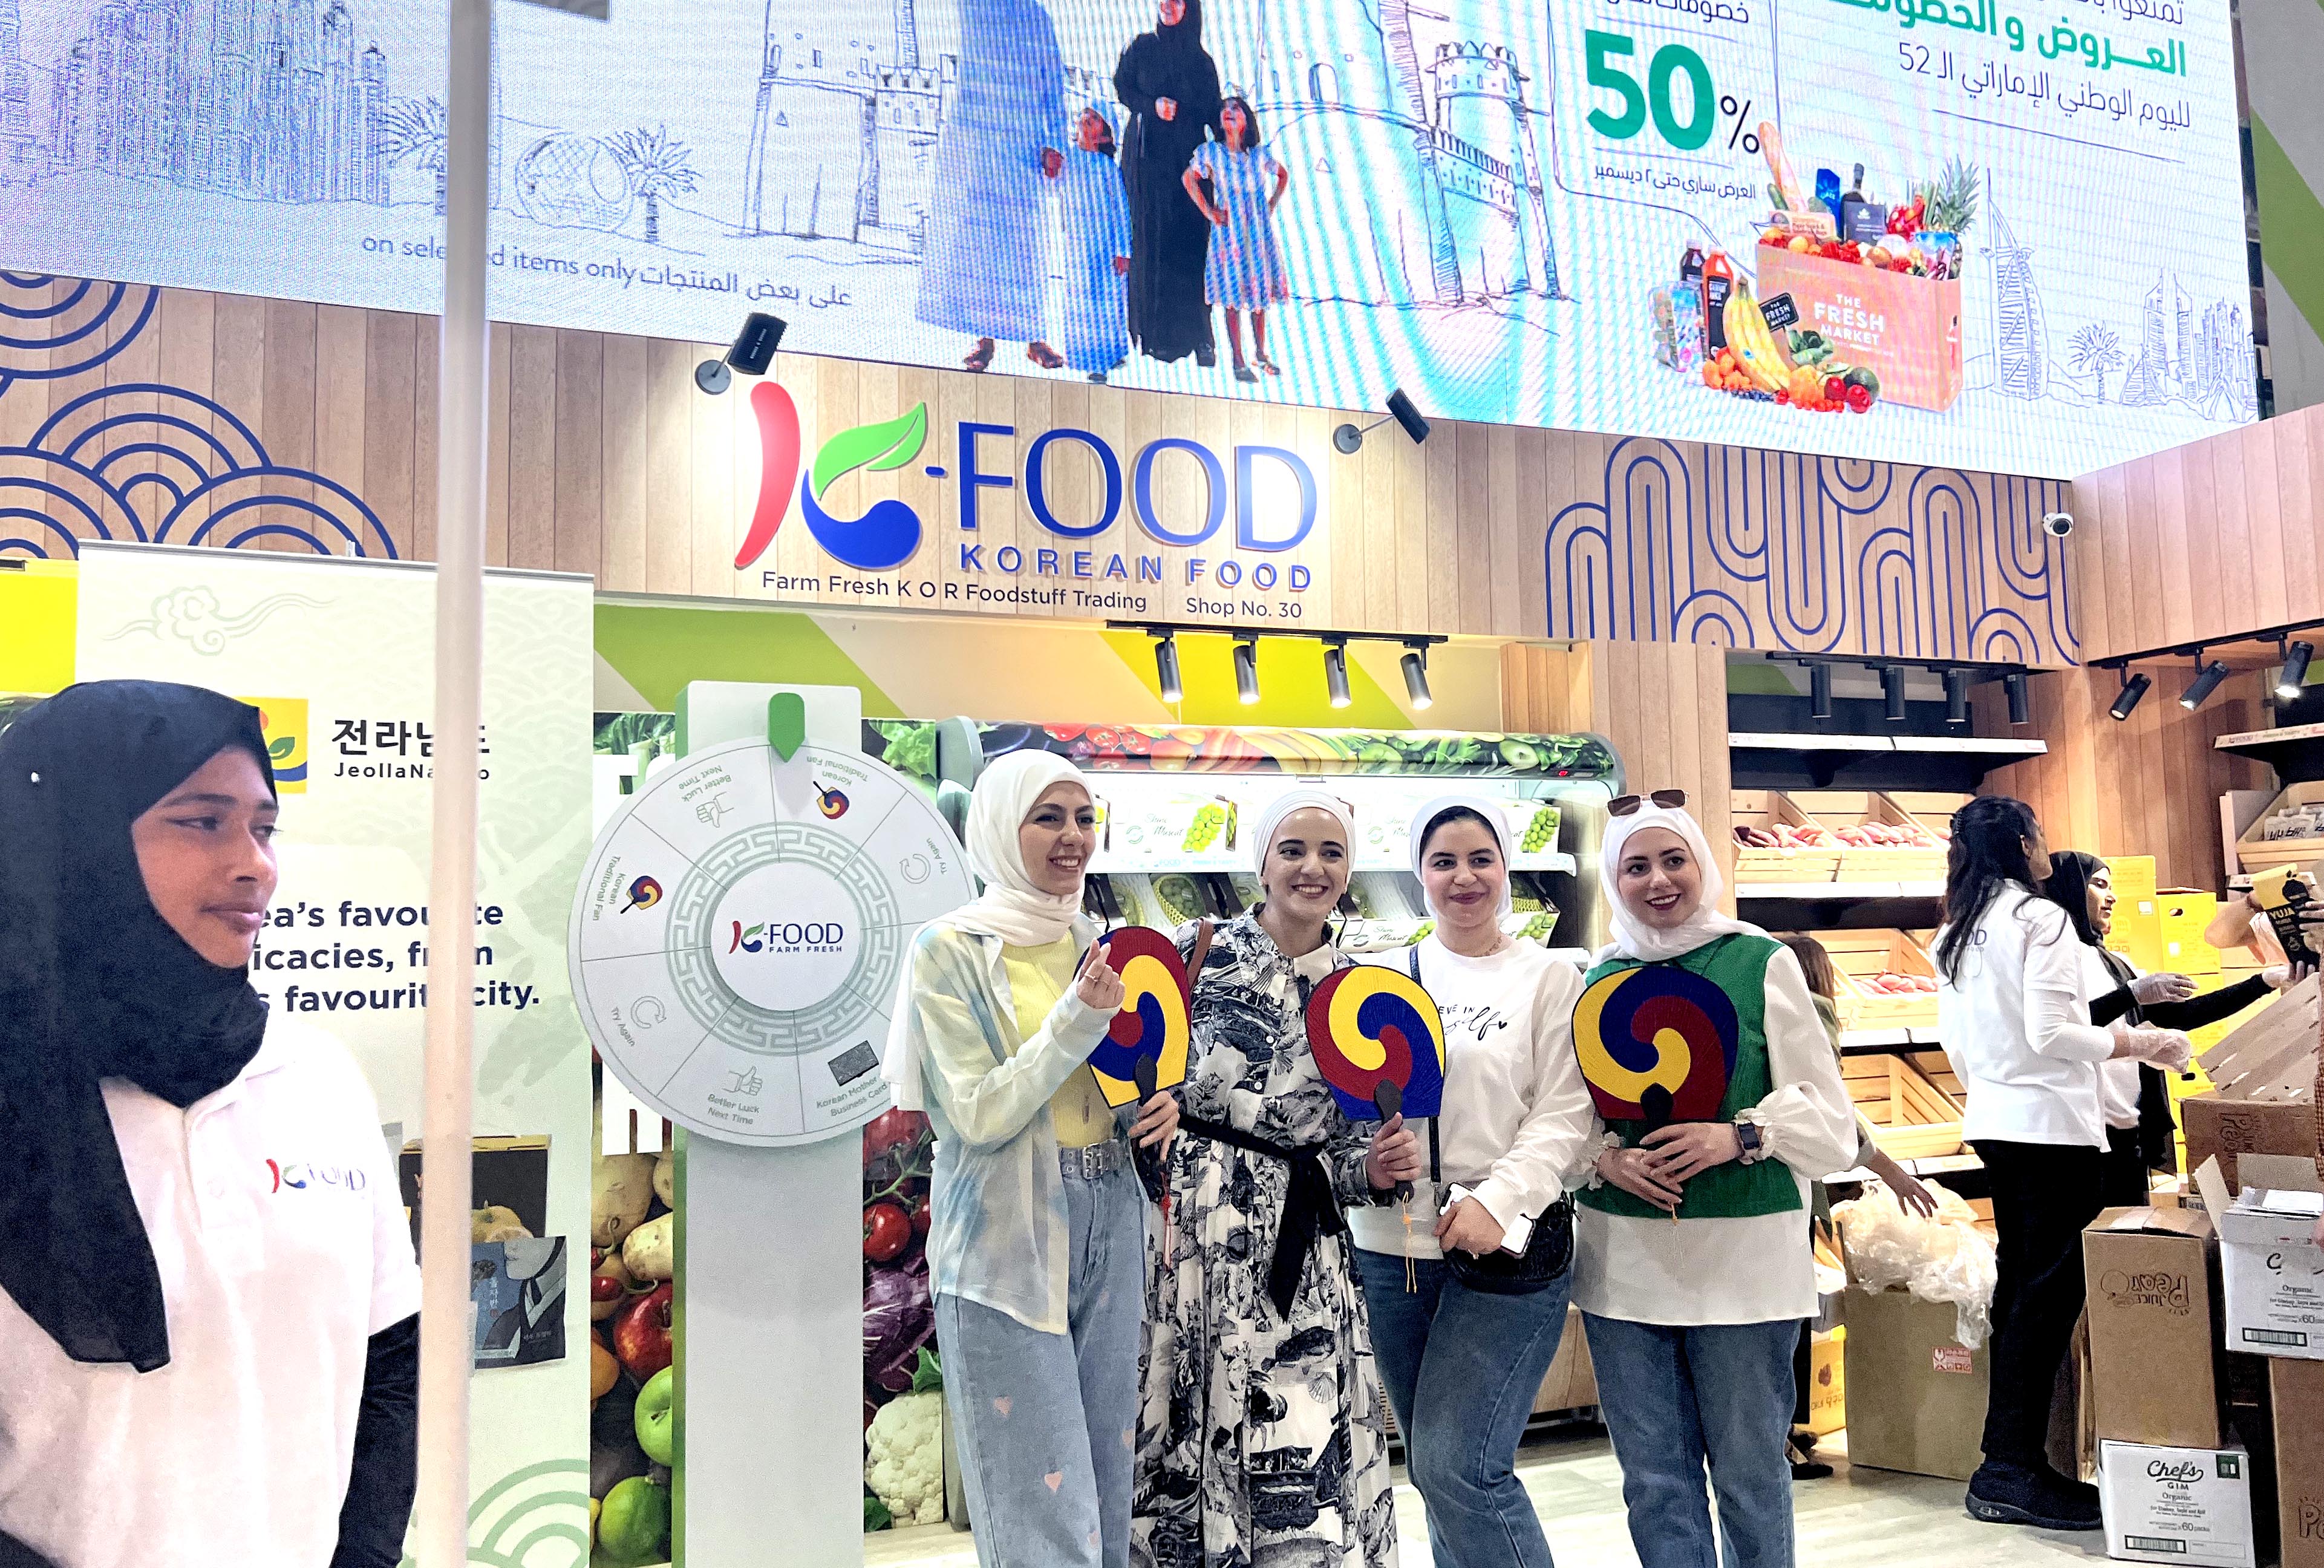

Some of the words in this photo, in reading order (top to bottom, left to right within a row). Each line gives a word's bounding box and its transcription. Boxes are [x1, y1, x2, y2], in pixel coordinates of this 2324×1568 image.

[2005, 16, 2025, 52] و
[1899, 42, 1930, 74] 52
[1962, 60, 2049, 108] الإماراتي
[2058, 81, 2132, 118] الوطني
[2140, 100, 2190, 131] لليوم
[1594, 165, 1642, 183] ديسمبر
[1653, 172, 1680, 189] حتى
[1683, 176, 1715, 194] ساري
[1718, 182, 1755, 200] العرض
[362, 237, 394, 253] on
[402, 240, 503, 269] seled
[513, 249, 579, 275] items
[586, 258, 635, 289] only
[640, 264, 737, 293] المنتجات
[746, 278, 799, 305] بعض
[809, 285, 852, 308] على
[1836, 294, 1861, 309] THE
[1814, 302, 1885, 333] FRESH
[1820, 324, 1879, 345] MARKET
[960, 543, 1163, 583] KOREAN
[1187, 558, 1311, 592] FOOD
[762, 571, 820, 592] Farm
[829, 575, 889, 596] Fresh
[899, 581, 913, 597] K
[919, 581, 936, 599] O
[945, 583, 959, 599] R
[967, 583, 1066, 606] Foodstuff
[1073, 590, 1148, 612] Trading
[1186, 597, 1235, 618] Shop
[1242, 599, 1273, 617] No.
[1278, 601, 1303, 618] 30
[331, 719, 490, 757] 전라
[700, 765, 722, 779] Next
[806, 756, 823, 766] Fan
[825, 760, 869, 782] Traditional
[678, 776, 701, 789] Time
[705, 774, 732, 791] Better
[821, 771, 852, 786] Korean
[681, 788, 703, 802] Luck
[1146, 813, 1168, 825] Shine
[1153, 826, 1184, 837] Muscat
[926, 837, 942, 860] Again
[596, 855, 621, 902] Traditional
[939, 861, 948, 875] Try
[609, 872, 627, 905] Korean
[339, 900, 503, 927] favote
[592, 903, 603, 921] Fan
[2270, 907, 2295, 920] YUJA
[253, 942, 394, 972] icacies,
[285, 983, 428, 1012] favourit
[474, 980, 539, 1009] city.
[611, 1006, 621, 1021] Try
[618, 1023, 635, 1048] Again
[707, 1093, 736, 1109] Better
[737, 1102, 760, 1114] Luck
[817, 1093, 847, 1109] Korean
[848, 1076, 878, 1096] Mother
[831, 1096, 867, 1117] Business
[867, 1083, 888, 1099] Card
[708, 1106, 728, 1120] Next
[731, 1114, 754, 1125] Time
[2131, 1272, 2190, 1308] Pear
[2136, 1293, 2166, 1307] JUICE
[2282, 1284, 2315, 1295] Organic
[2147, 1460, 2203, 1482] Chef's
[2162, 1492, 2192, 1501] Organic
